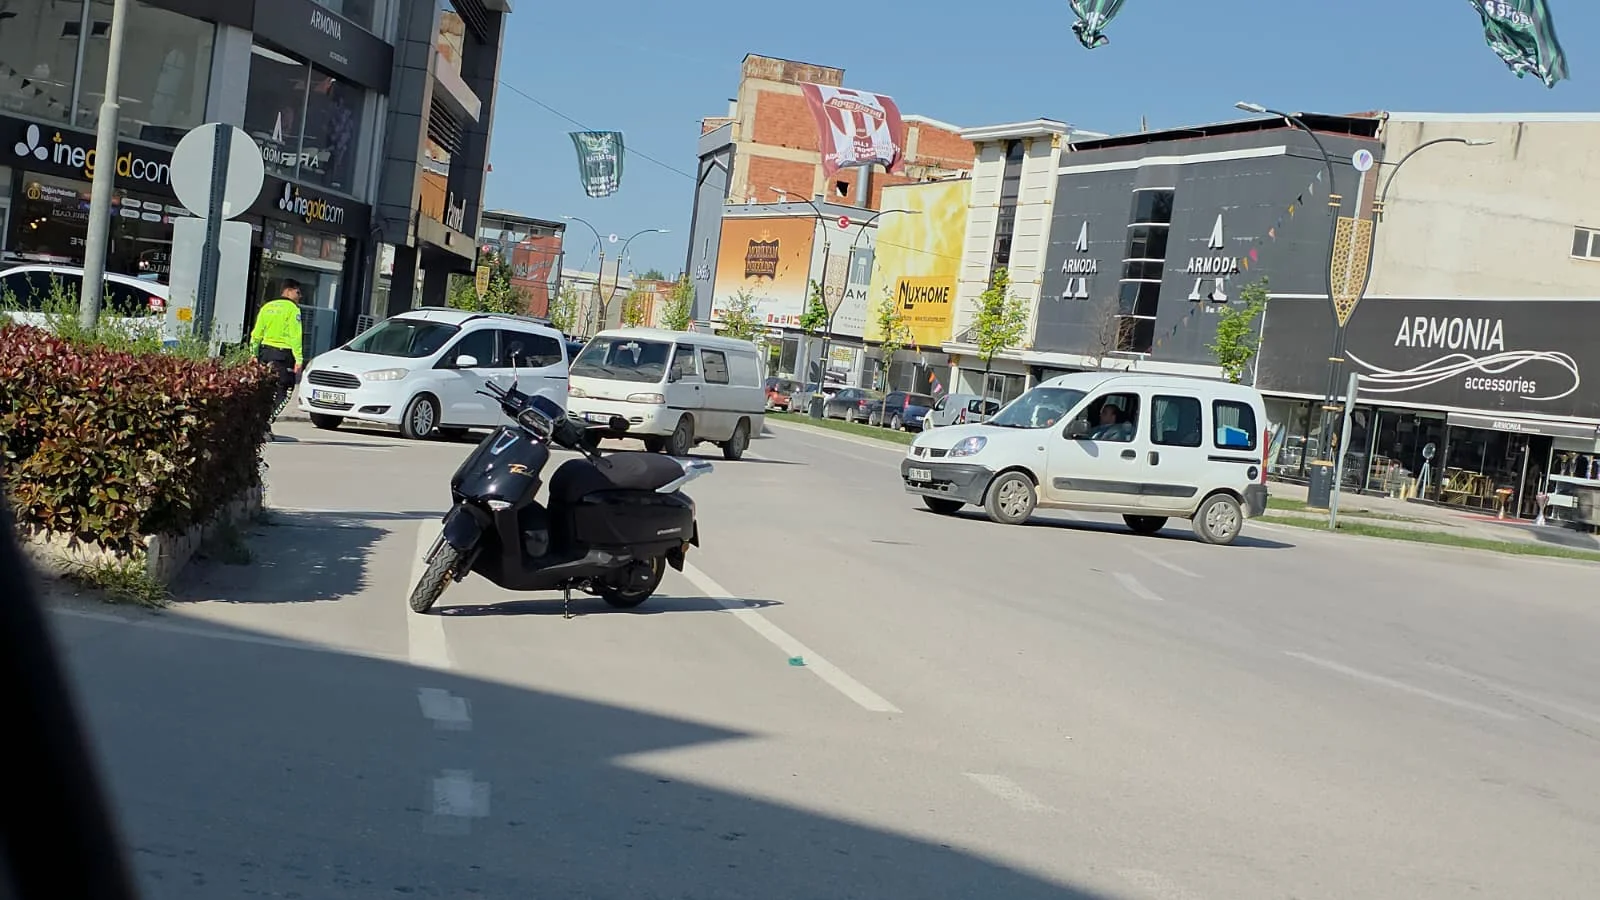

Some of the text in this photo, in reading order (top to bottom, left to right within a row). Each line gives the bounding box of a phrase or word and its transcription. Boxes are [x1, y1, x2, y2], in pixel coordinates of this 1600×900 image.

[310, 9, 341, 40] ARMONIA
[1061, 258, 1098, 273] ARMODA
[1186, 256, 1238, 273] ARMODA
[1394, 316, 1505, 351] ARMONIA
[1464, 376, 1536, 393] accessories
